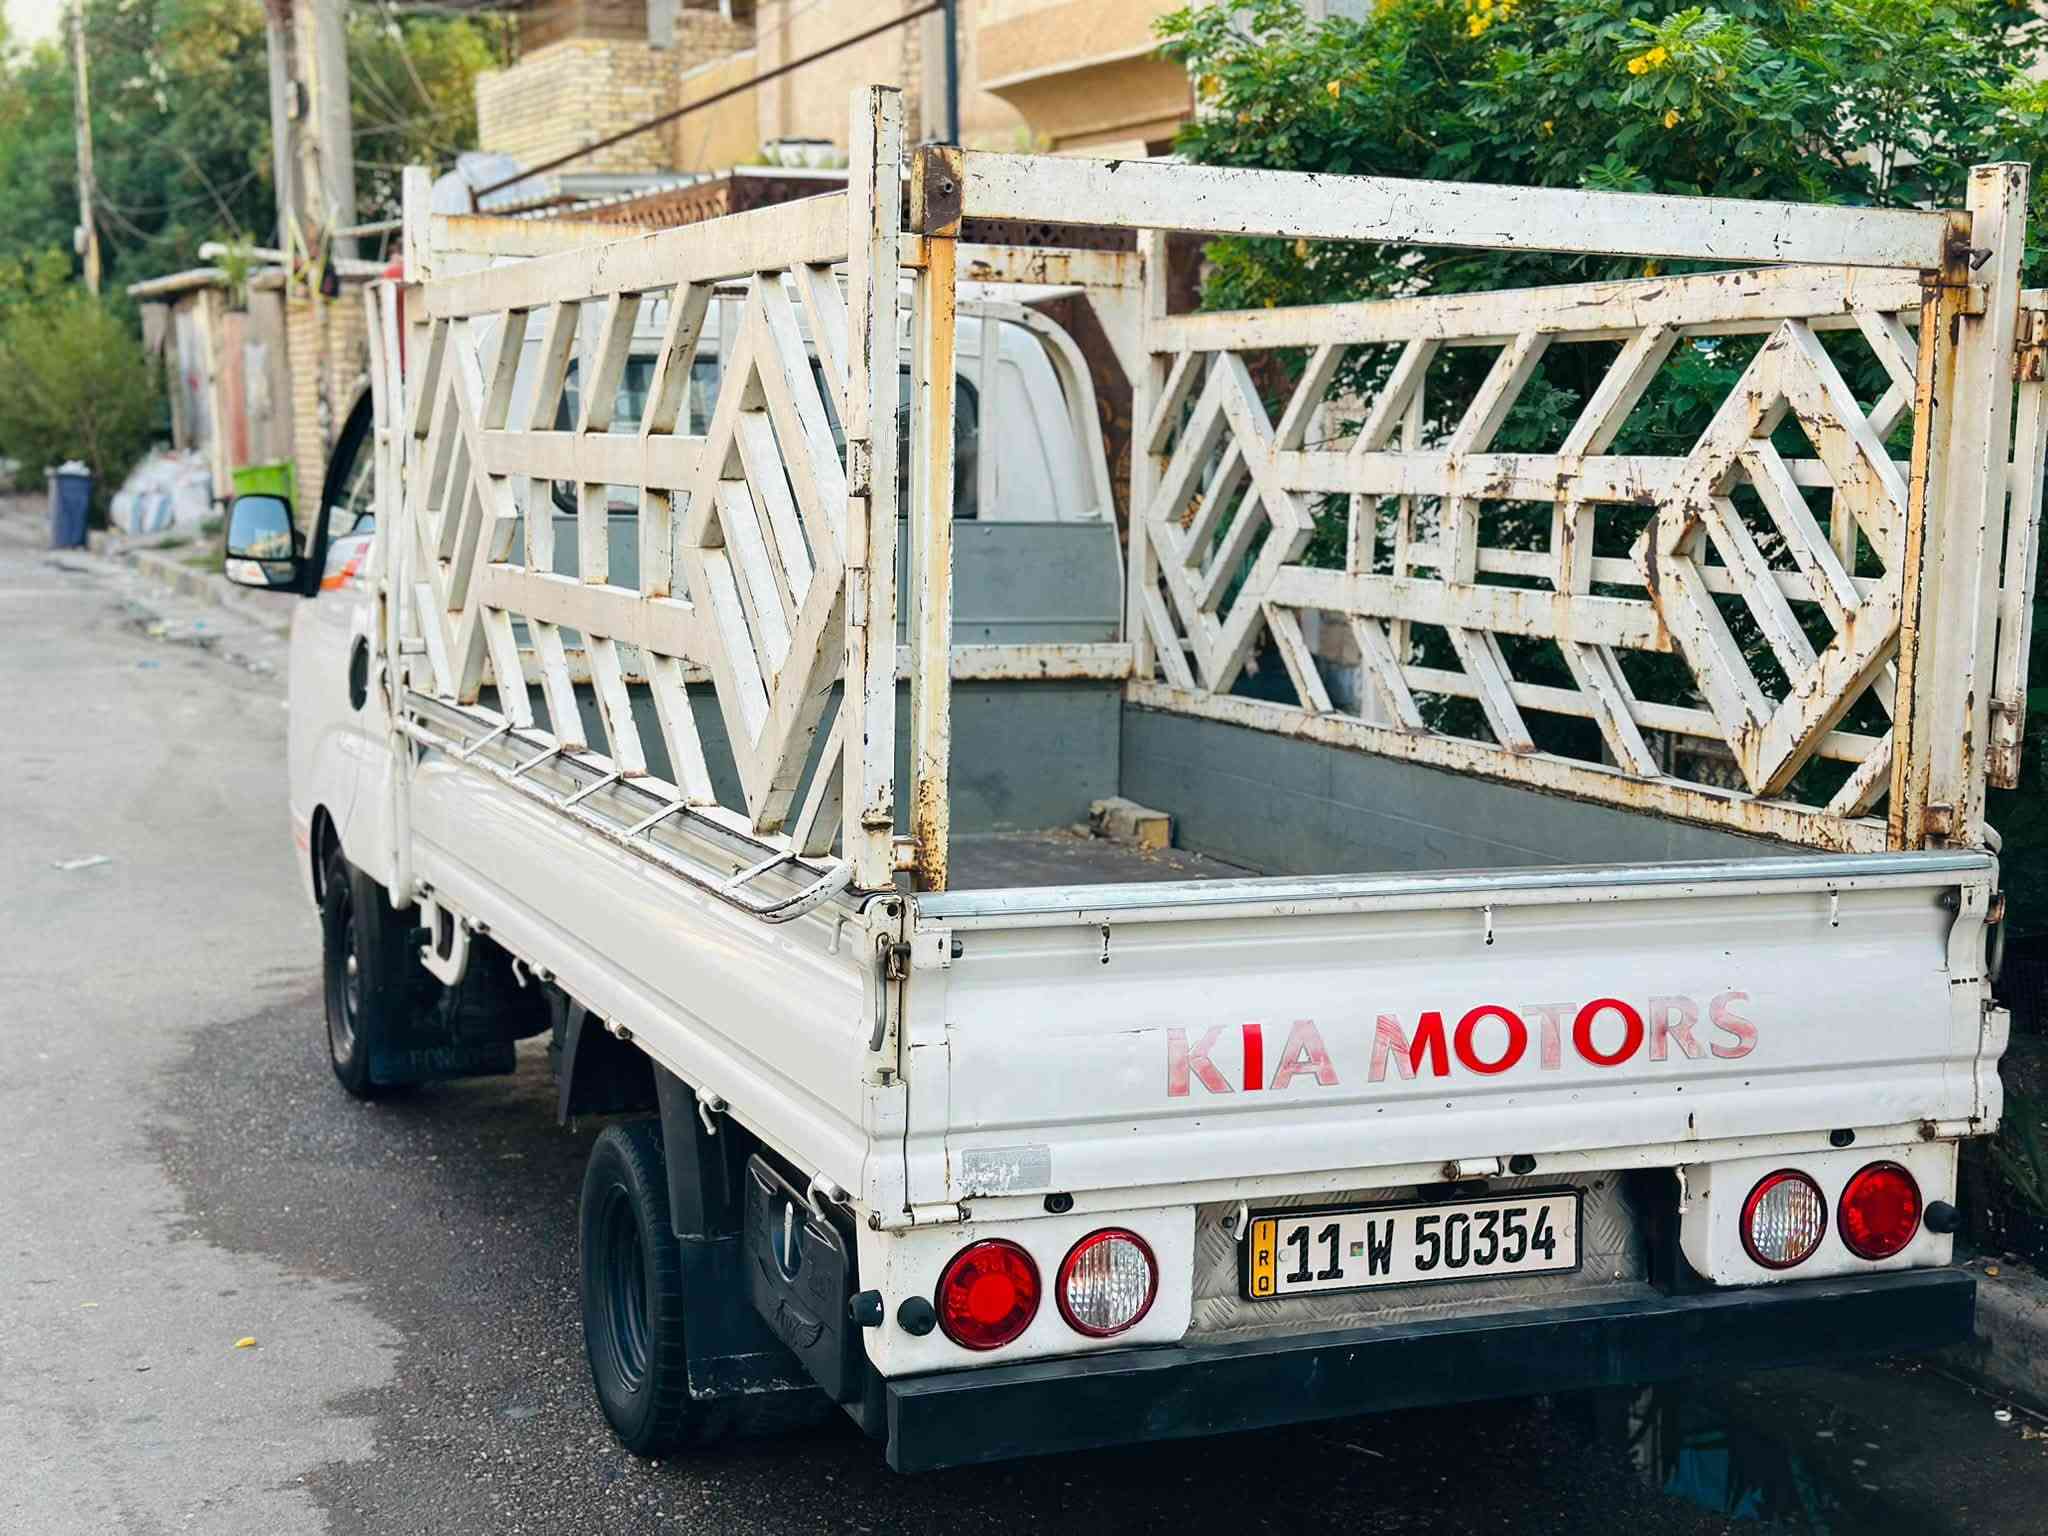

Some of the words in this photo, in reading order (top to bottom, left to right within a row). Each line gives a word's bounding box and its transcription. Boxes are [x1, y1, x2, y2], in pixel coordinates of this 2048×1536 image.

[1167, 1020, 1340, 1097] KIA
[1368, 991, 1759, 1083] MOTORS
[1286, 1223, 1344, 1284] 11
[1367, 1218, 1395, 1276] W
[1415, 1205, 1556, 1271] 50354
